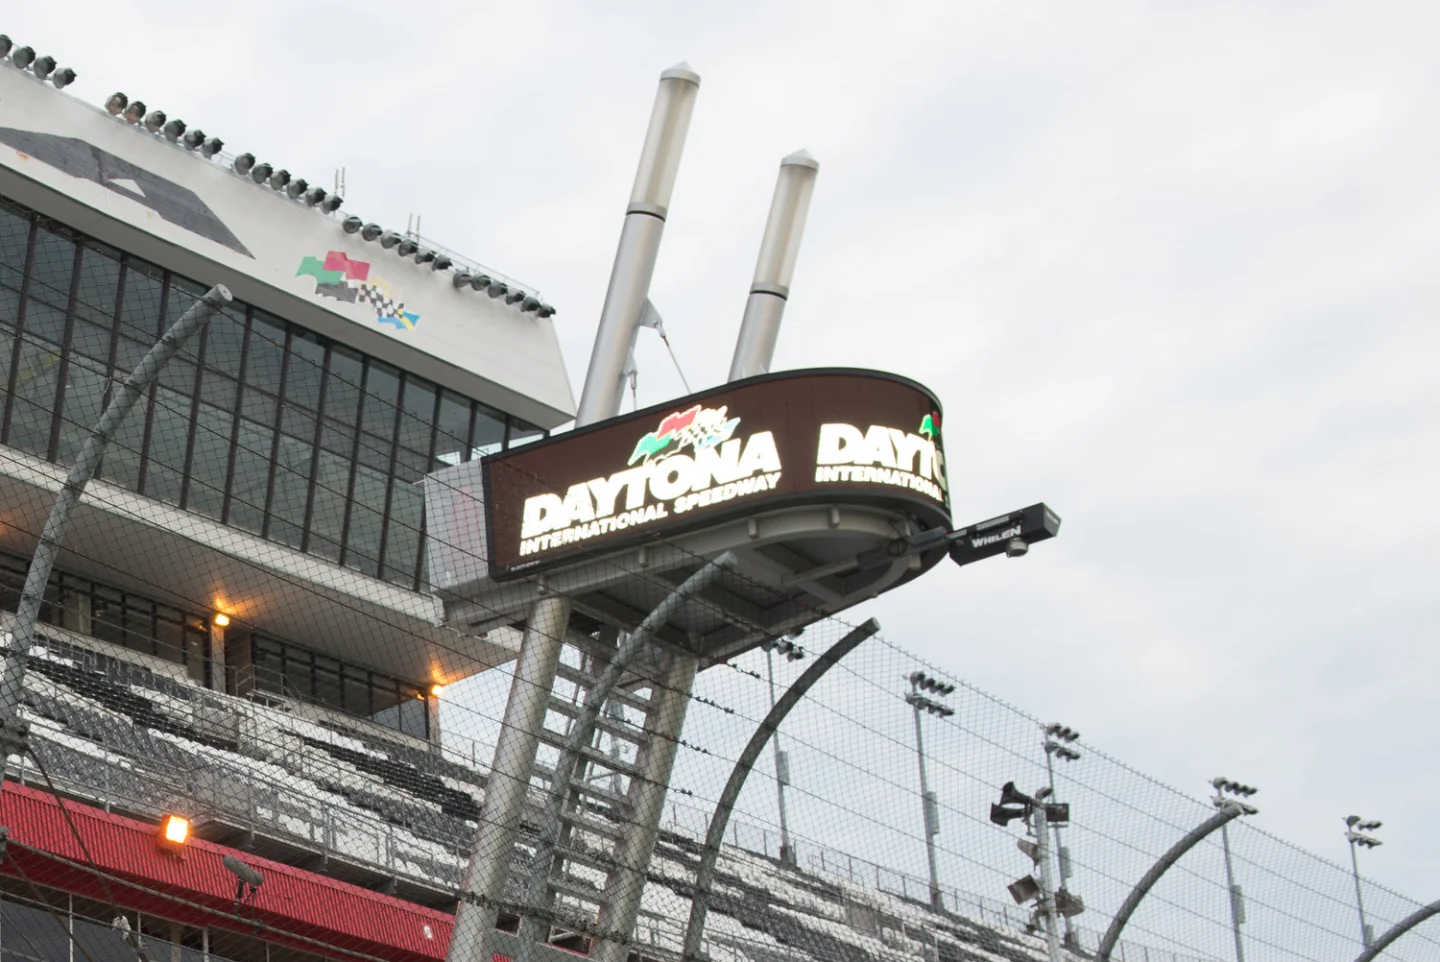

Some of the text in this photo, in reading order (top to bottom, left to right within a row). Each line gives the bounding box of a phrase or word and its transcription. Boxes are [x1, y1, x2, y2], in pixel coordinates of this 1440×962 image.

[519, 472, 782, 556] INTERNATIONAL SPEEDWAY
[521, 430, 782, 539] DAYTONA
[815, 465, 948, 509] INTERNATIONA
